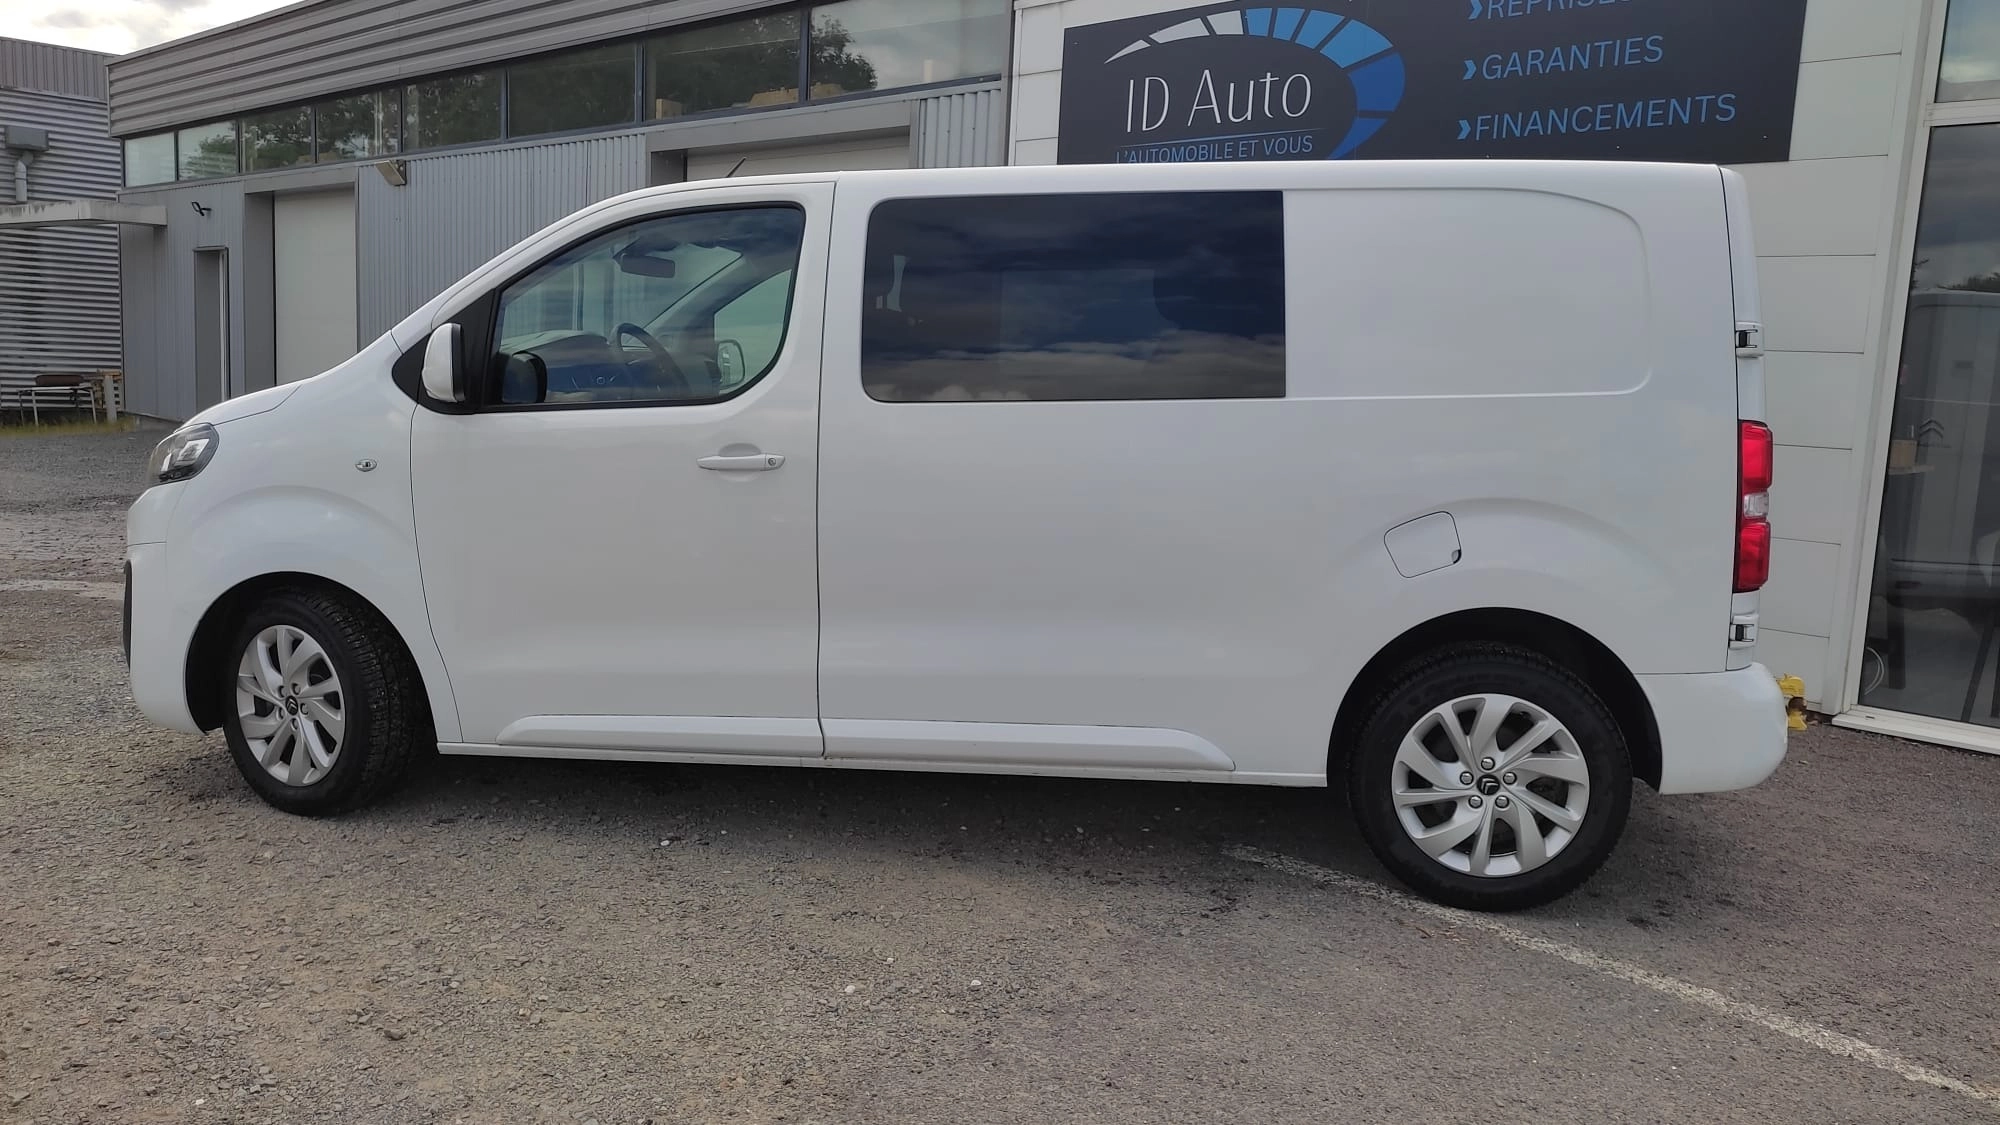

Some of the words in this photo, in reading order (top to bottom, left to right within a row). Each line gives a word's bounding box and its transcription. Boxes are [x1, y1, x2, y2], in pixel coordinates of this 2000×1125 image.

[1482, 35, 1664, 80] GARANTIES
[1127, 76, 1170, 133] ID
[1188, 69, 1311, 127] Auto
[1475, 93, 1736, 141] FINANCEMENTS
[1238, 140, 1258, 157] ET
[1264, 135, 1313, 155] VOUS
